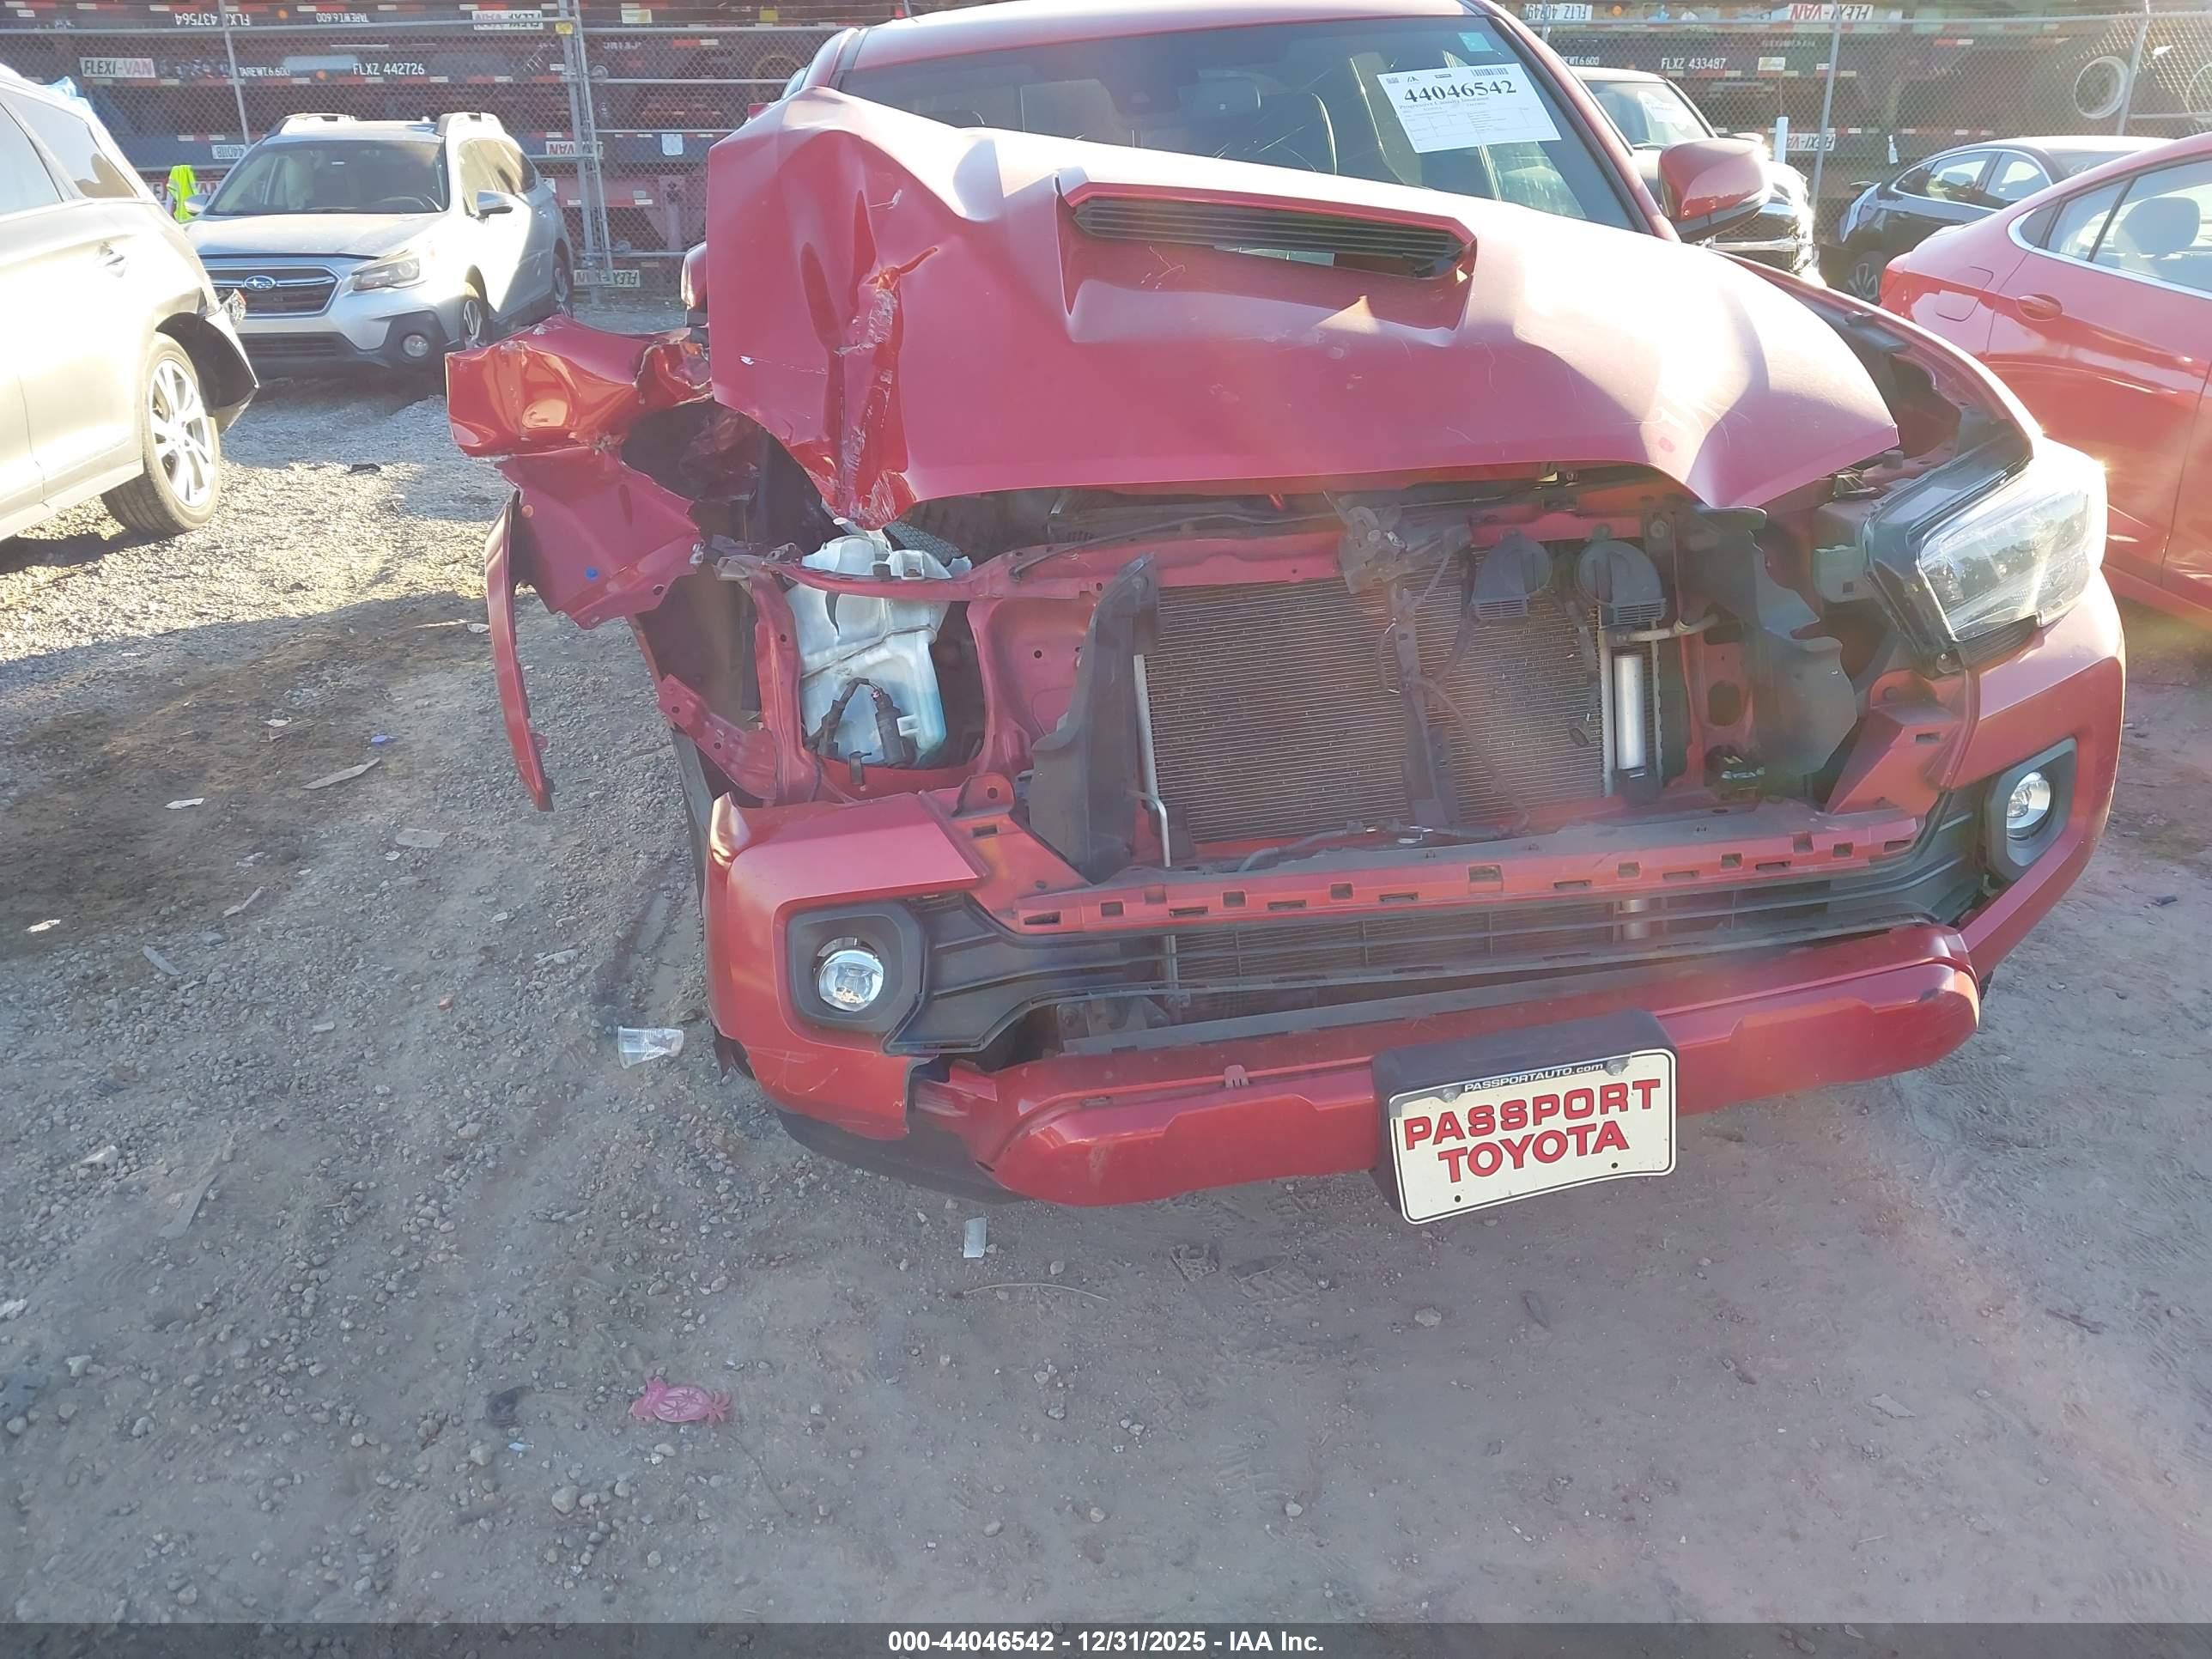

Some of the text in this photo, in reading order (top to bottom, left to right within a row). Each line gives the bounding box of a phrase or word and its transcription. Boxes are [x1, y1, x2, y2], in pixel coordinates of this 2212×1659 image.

[174, 13, 218, 26] 437564
[82, 59, 154, 76] FLEXI-VAN
[352, 62, 425, 76] FLXZ 442726
[1661, 58, 1727, 70] FLXZ 433487
[1404, 80, 1516, 102] 44046542
[1464, 1064, 1603, 1092] PASSPORTAUTO.com
[1404, 1079, 1661, 1150] PASSPORT
[1438, 1121, 1630, 1183] TOYOTA
